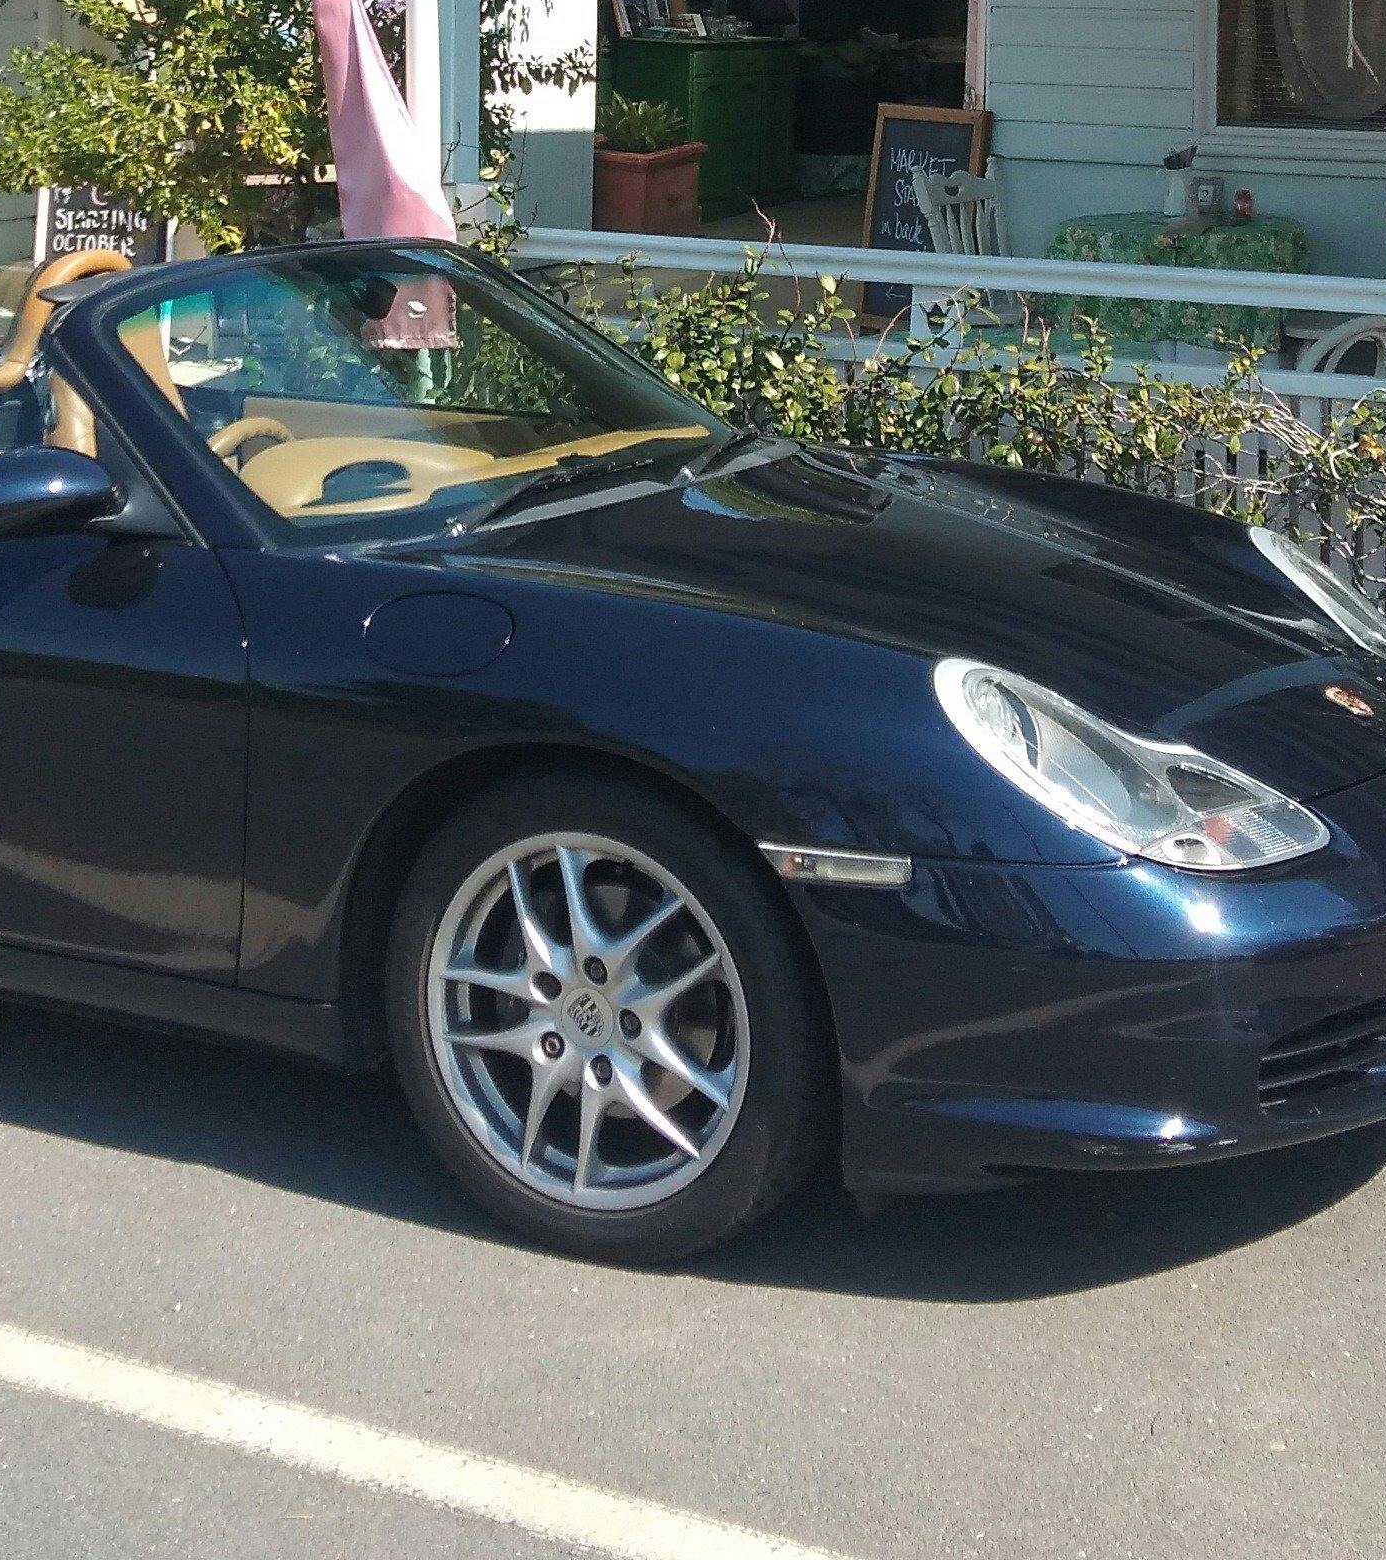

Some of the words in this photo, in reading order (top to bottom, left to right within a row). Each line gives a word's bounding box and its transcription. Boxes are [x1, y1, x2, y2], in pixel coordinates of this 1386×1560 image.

[889, 146, 958, 178] MARKET
[54, 207, 149, 233] STARTING
[52, 233, 138, 258] OCTOBER
